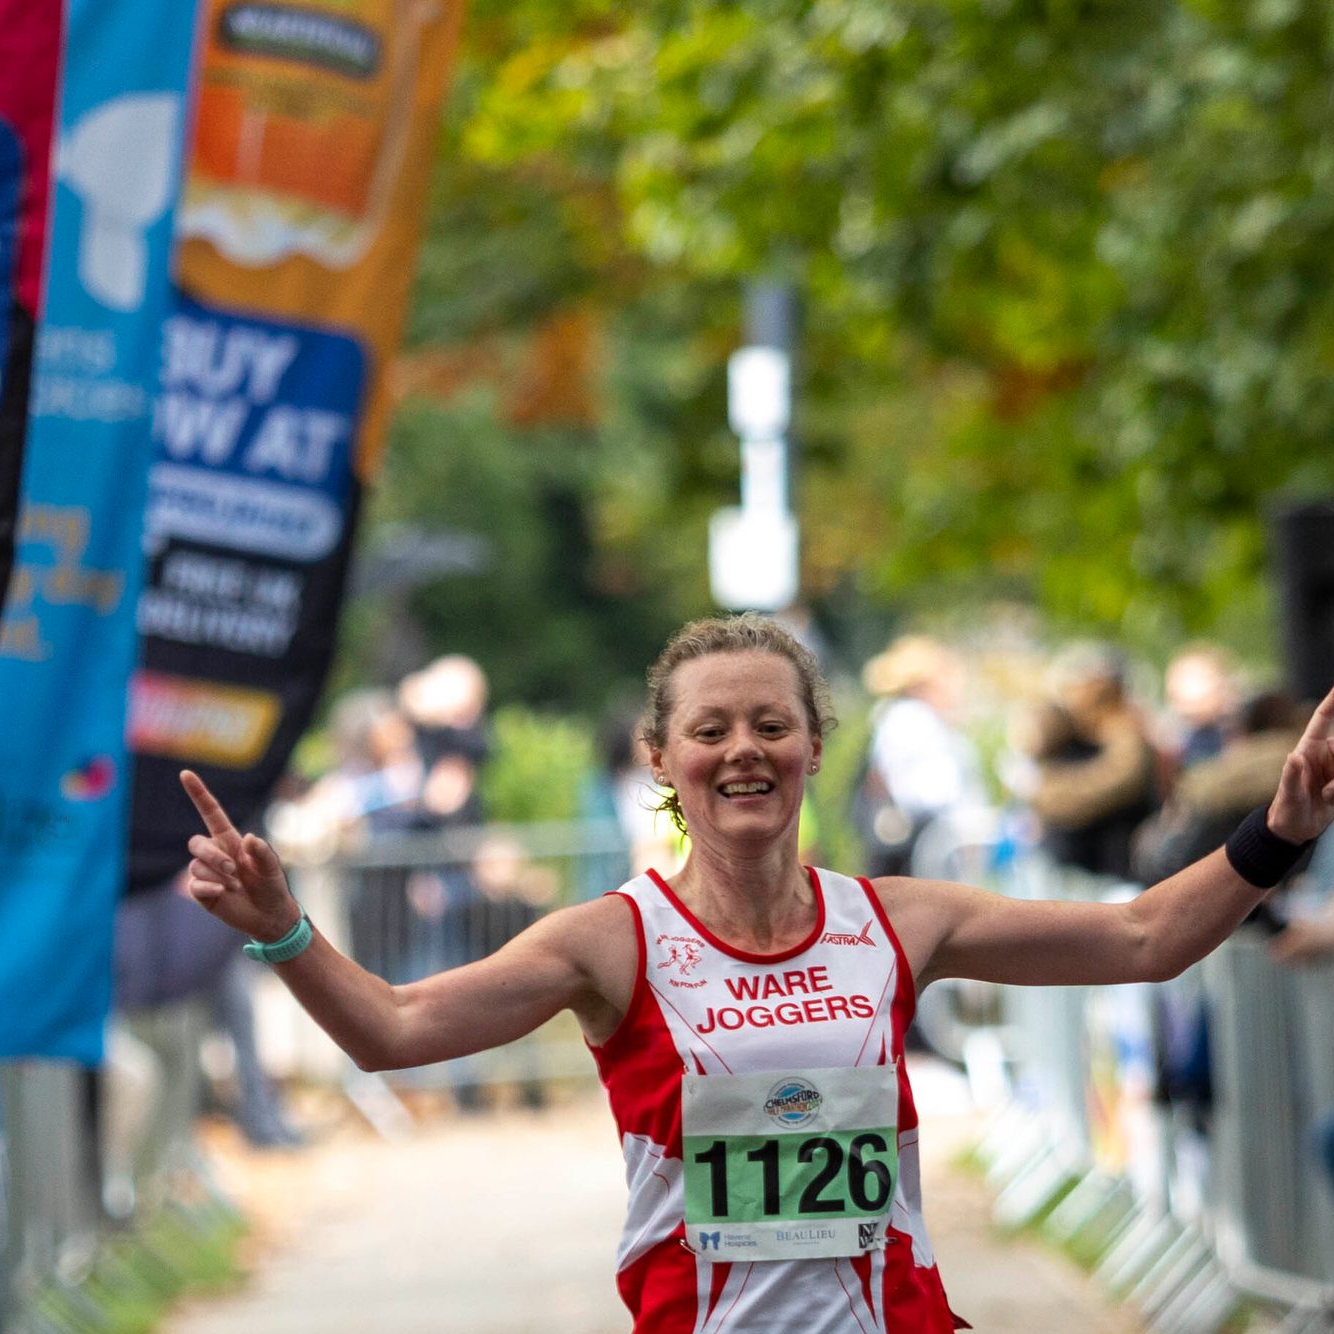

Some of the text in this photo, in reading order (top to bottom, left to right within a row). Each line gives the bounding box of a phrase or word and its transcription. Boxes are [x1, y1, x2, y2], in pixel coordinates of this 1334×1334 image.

[724, 966, 834, 1001] WARE
[696, 995, 875, 1034] JOGGERS
[765, 1089, 820, 1109] CHELMSFORD
[695, 1133, 892, 1217] 1126
[776, 1229, 836, 1241] BEAULIEU
